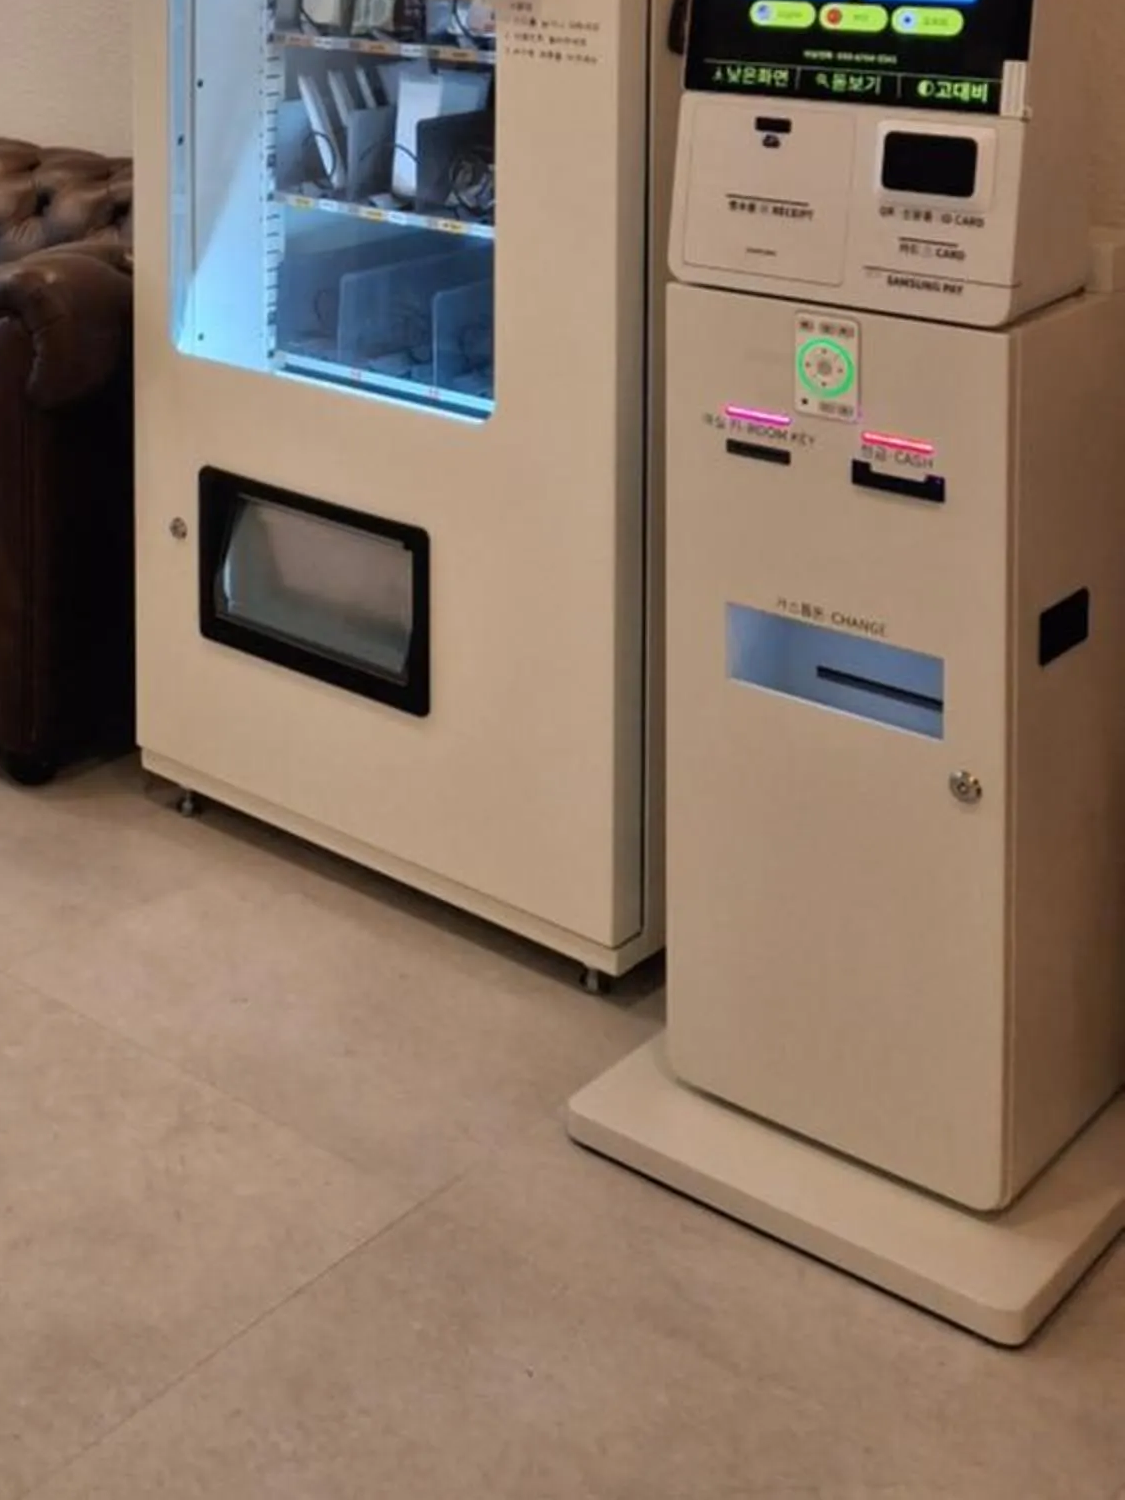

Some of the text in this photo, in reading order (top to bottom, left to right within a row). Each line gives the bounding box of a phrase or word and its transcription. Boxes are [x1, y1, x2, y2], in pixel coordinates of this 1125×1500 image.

[935, 80, 989, 104] 고대비
[955, 214, 986, 228] CARD
[935, 247, 967, 261] CARD
[886, 275, 964, 296] SAMSUNG PAY
[894, 449, 936, 469] CASH
[830, 610, 890, 638] CHANGE
